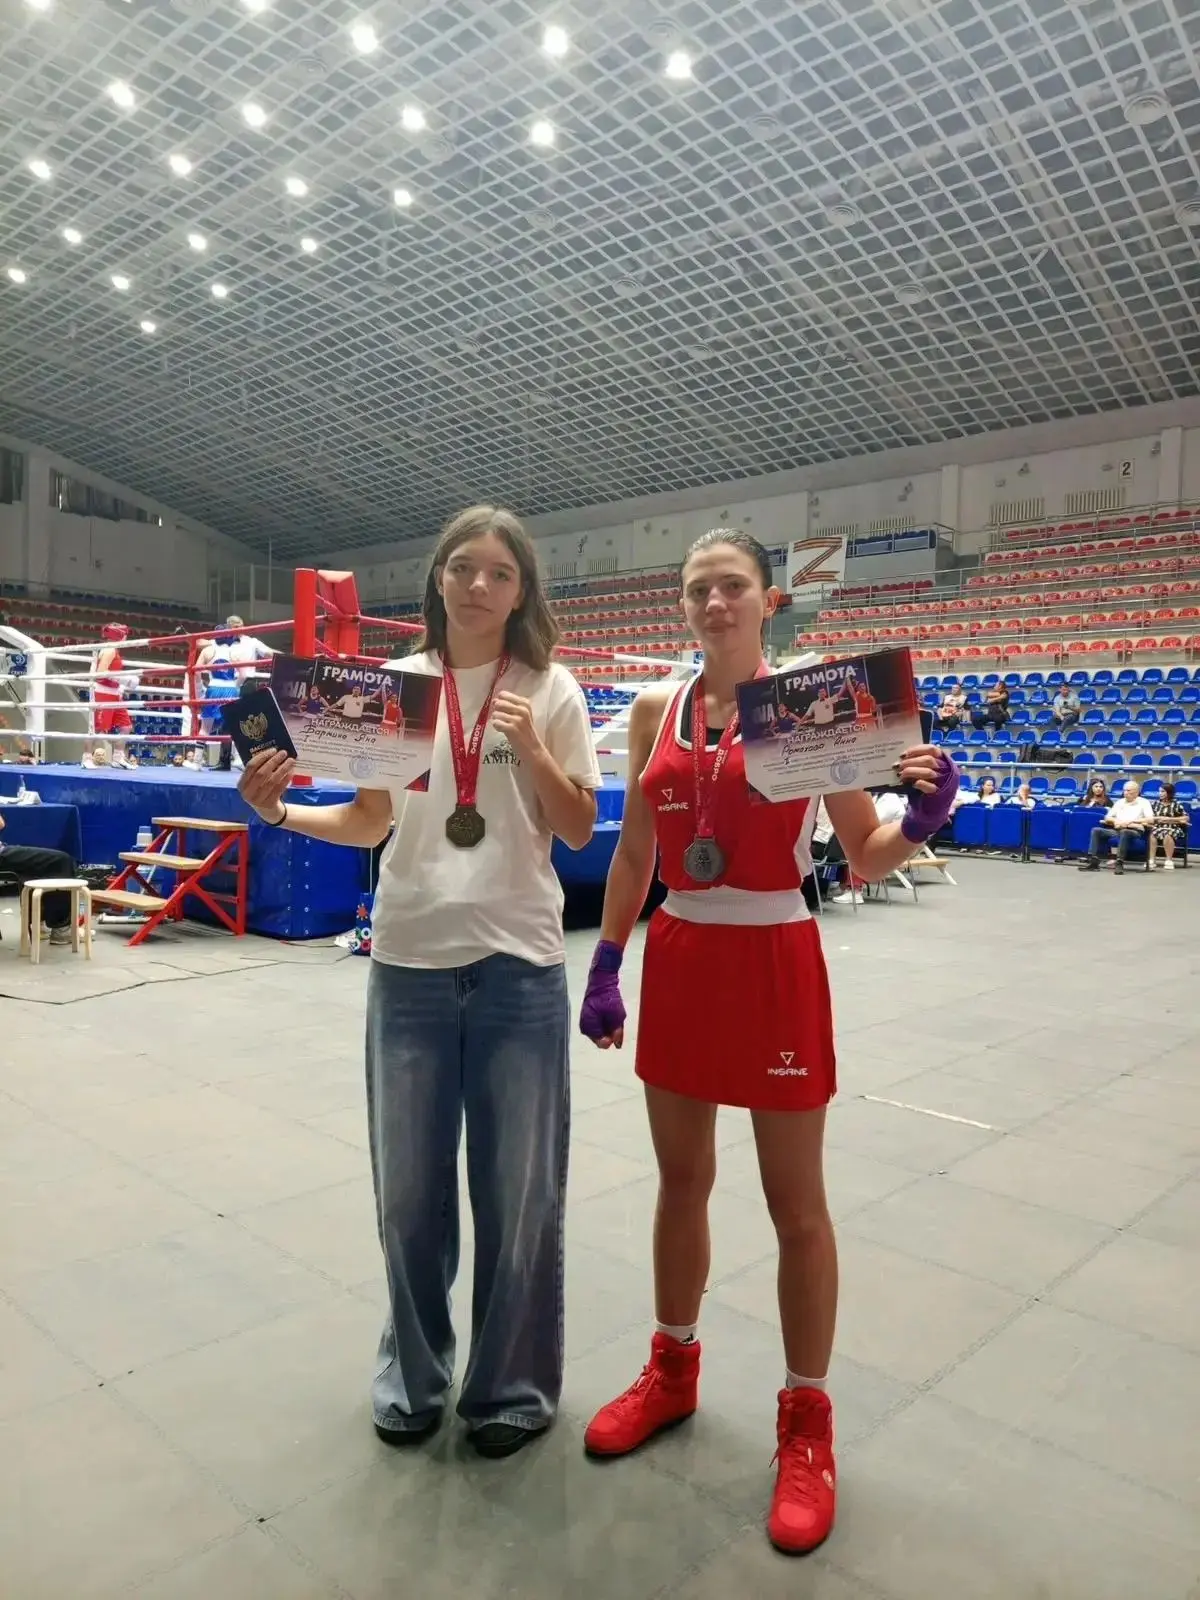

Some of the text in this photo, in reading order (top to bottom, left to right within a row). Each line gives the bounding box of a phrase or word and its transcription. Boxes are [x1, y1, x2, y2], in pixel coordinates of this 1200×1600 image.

[1122, 461, 1131, 476] 2
[792, 536, 843, 588] Z
[322, 665, 394, 687] ГРАМОТА
[784, 665, 857, 691] ГРАМОТА
[311, 718, 390, 736] НАГРАЖДАЕТСЯ
[787, 723, 867, 744] НАГРАЖДАЕТСЯ
[354, 733, 377, 744] Яна
[767, 1068, 809, 1076] INSANE
